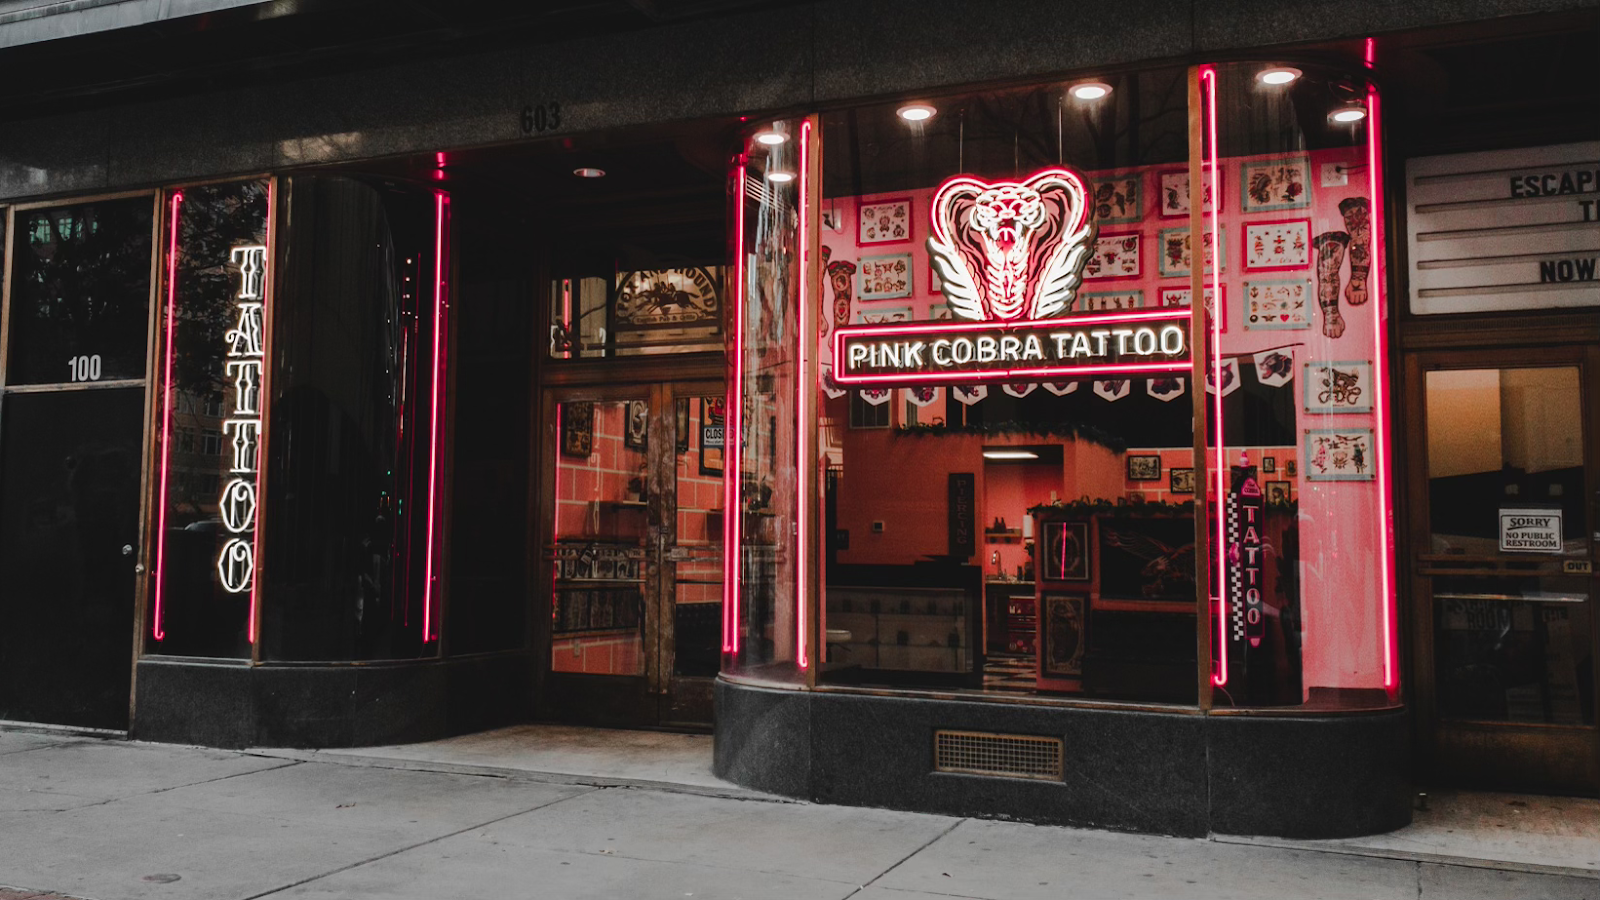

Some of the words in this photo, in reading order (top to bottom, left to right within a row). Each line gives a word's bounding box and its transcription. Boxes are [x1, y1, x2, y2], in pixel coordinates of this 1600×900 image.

[521, 102, 560, 133] 603
[1510, 170, 1600, 198] ESCAP
[1540, 258, 1596, 283] NOW
[850, 340, 924, 370] PINK
[932, 333, 1045, 367] COBRA
[1050, 325, 1186, 360] TATTOO
[68, 354, 101, 382] 100
[217, 246, 267, 594] TATTOO
[956, 480, 968, 545] PIERCING
[1510, 517, 1551, 527] SORRY
[1521, 532, 1555, 540] PUBLIC
[1243, 505, 1261, 624] TATTOO
[1567, 562, 1588, 570] OUT
